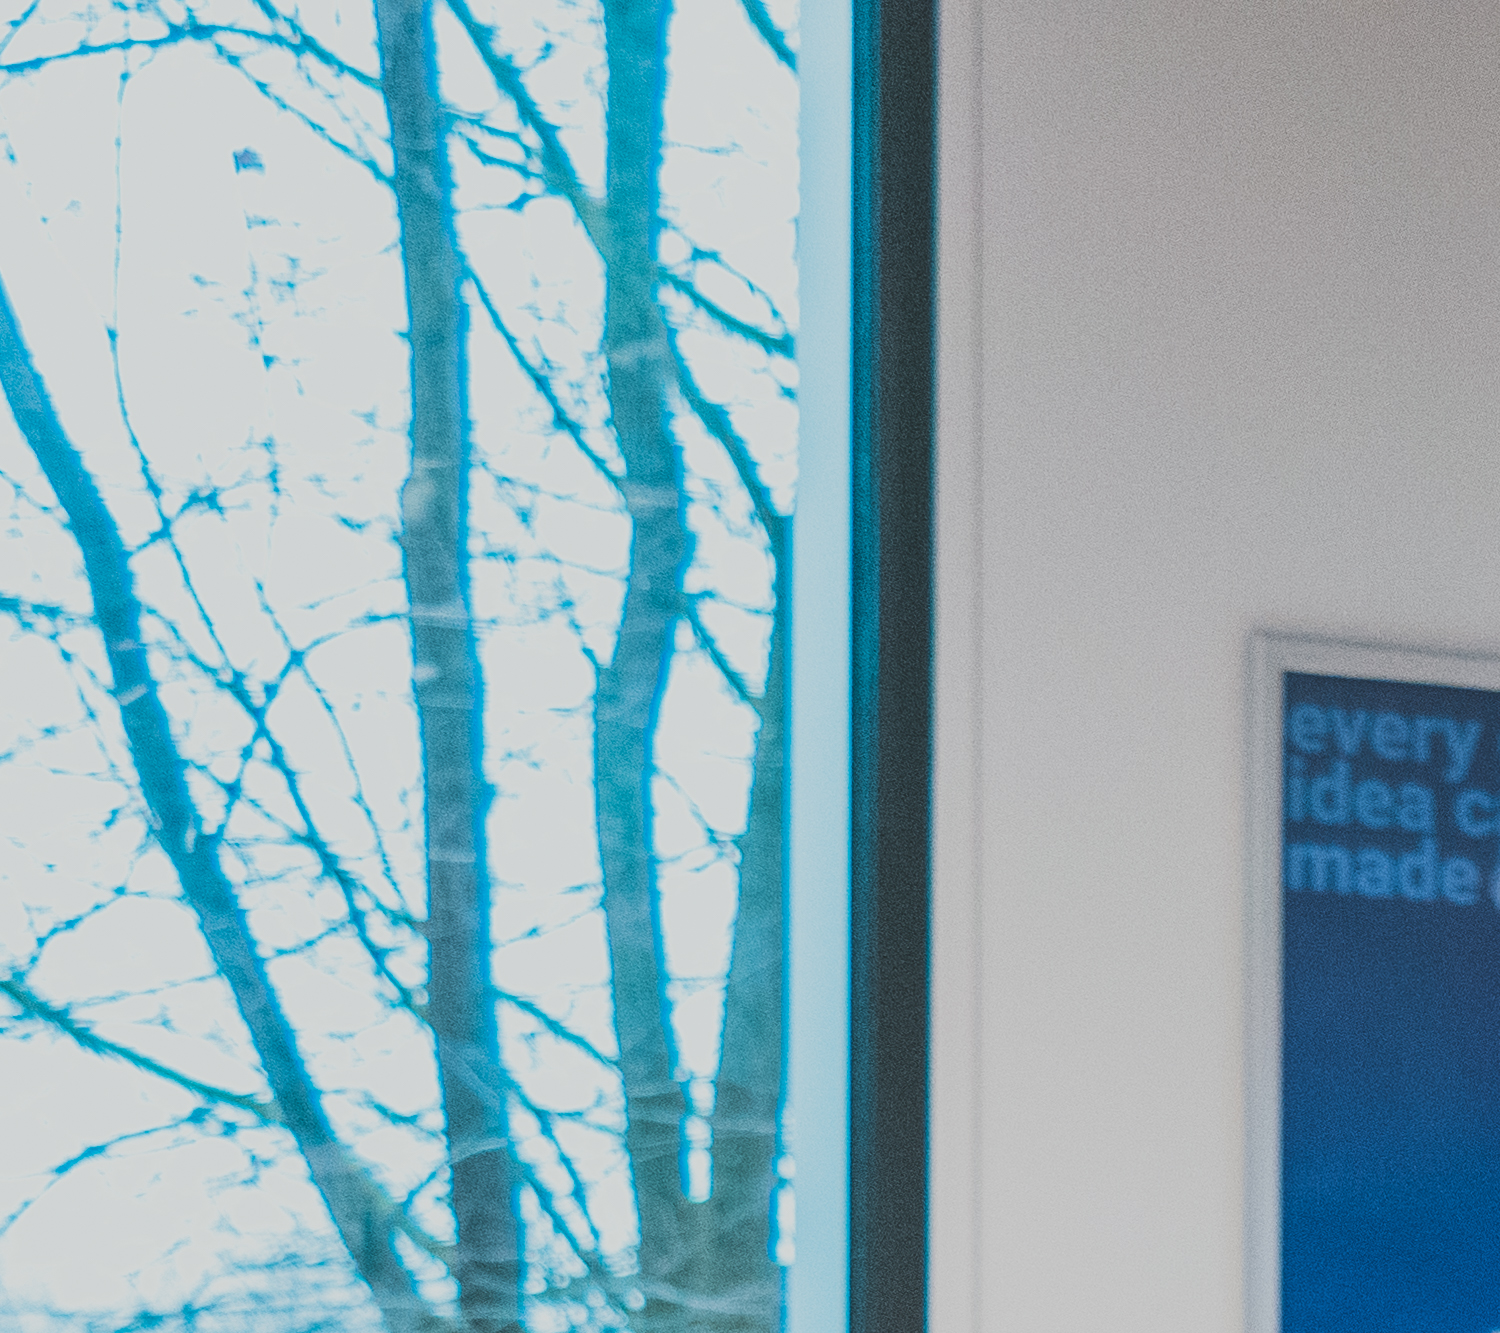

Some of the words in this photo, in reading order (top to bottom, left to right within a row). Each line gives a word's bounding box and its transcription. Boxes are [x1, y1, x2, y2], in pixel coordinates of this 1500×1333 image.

[1287, 702, 1482, 783] every
[1286, 757, 1436, 833] idea
[1286, 837, 1482, 905] made
